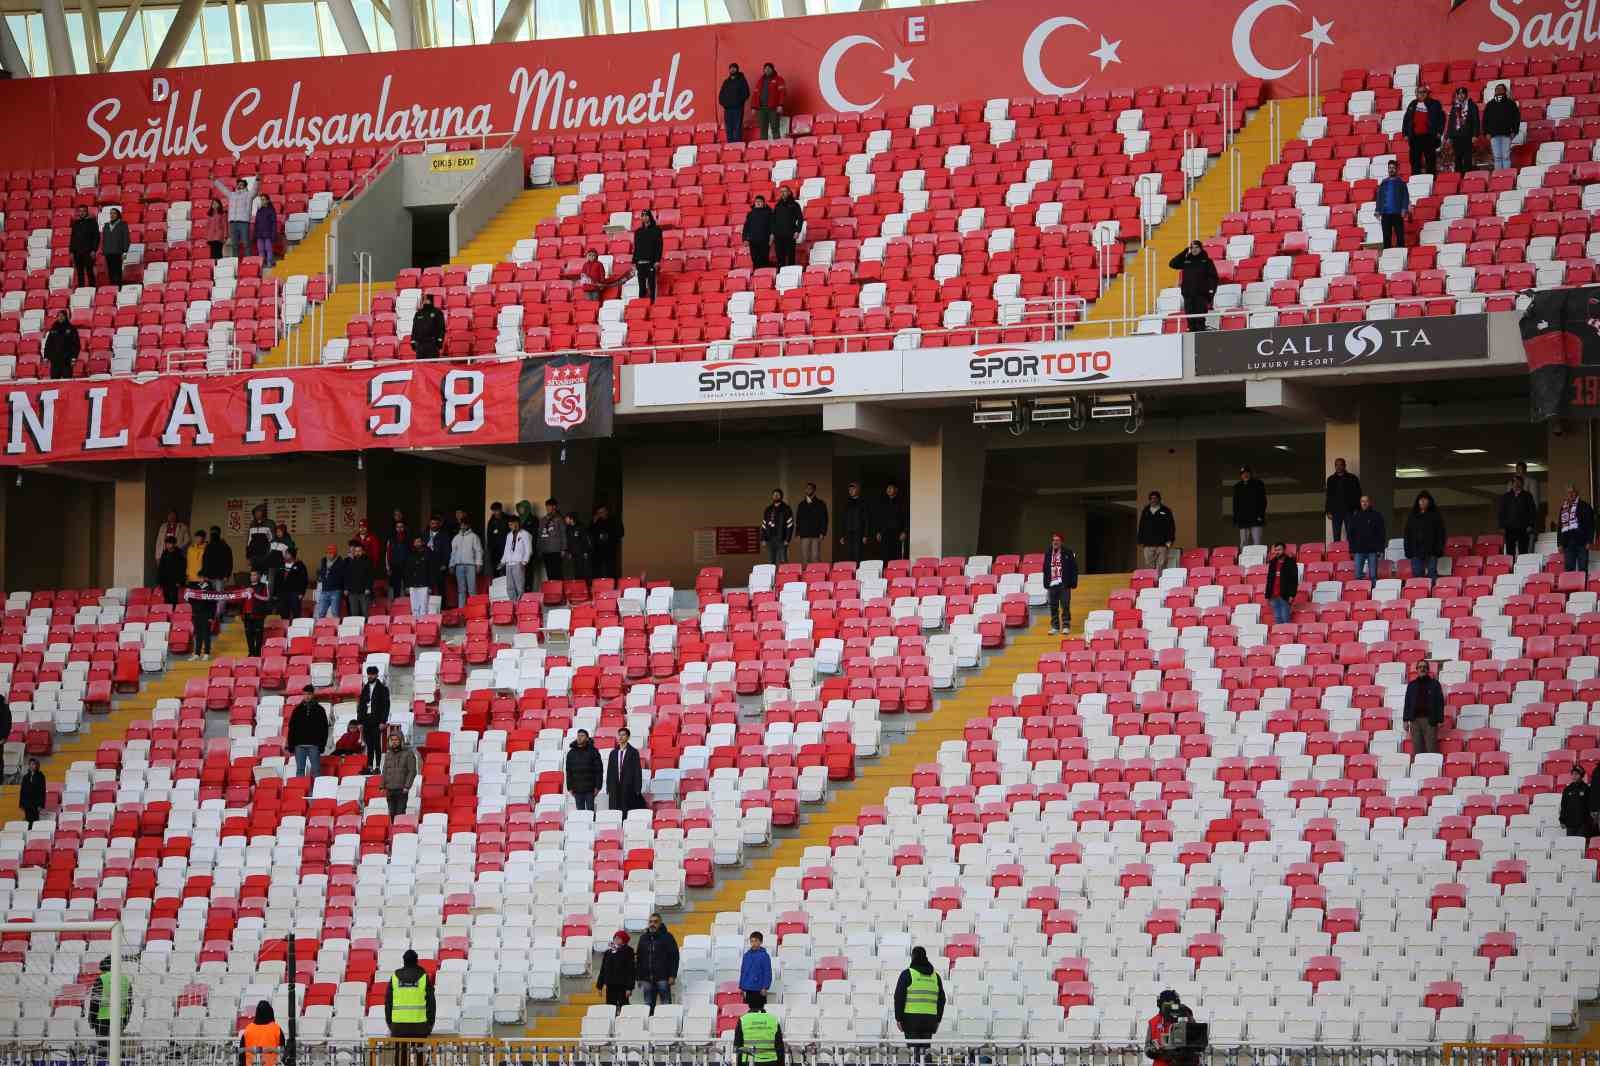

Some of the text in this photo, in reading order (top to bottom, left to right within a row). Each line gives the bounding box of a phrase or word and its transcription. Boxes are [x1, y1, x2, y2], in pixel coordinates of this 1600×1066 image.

[908, 16, 926, 42] E
[1477, 0, 1600, 53] Sağl
[151, 77, 169, 102] D
[76, 52, 695, 165] Sağlık Çalışanlarına Minnetle
[1247, 358, 1334, 369] LUXURY RESORT
